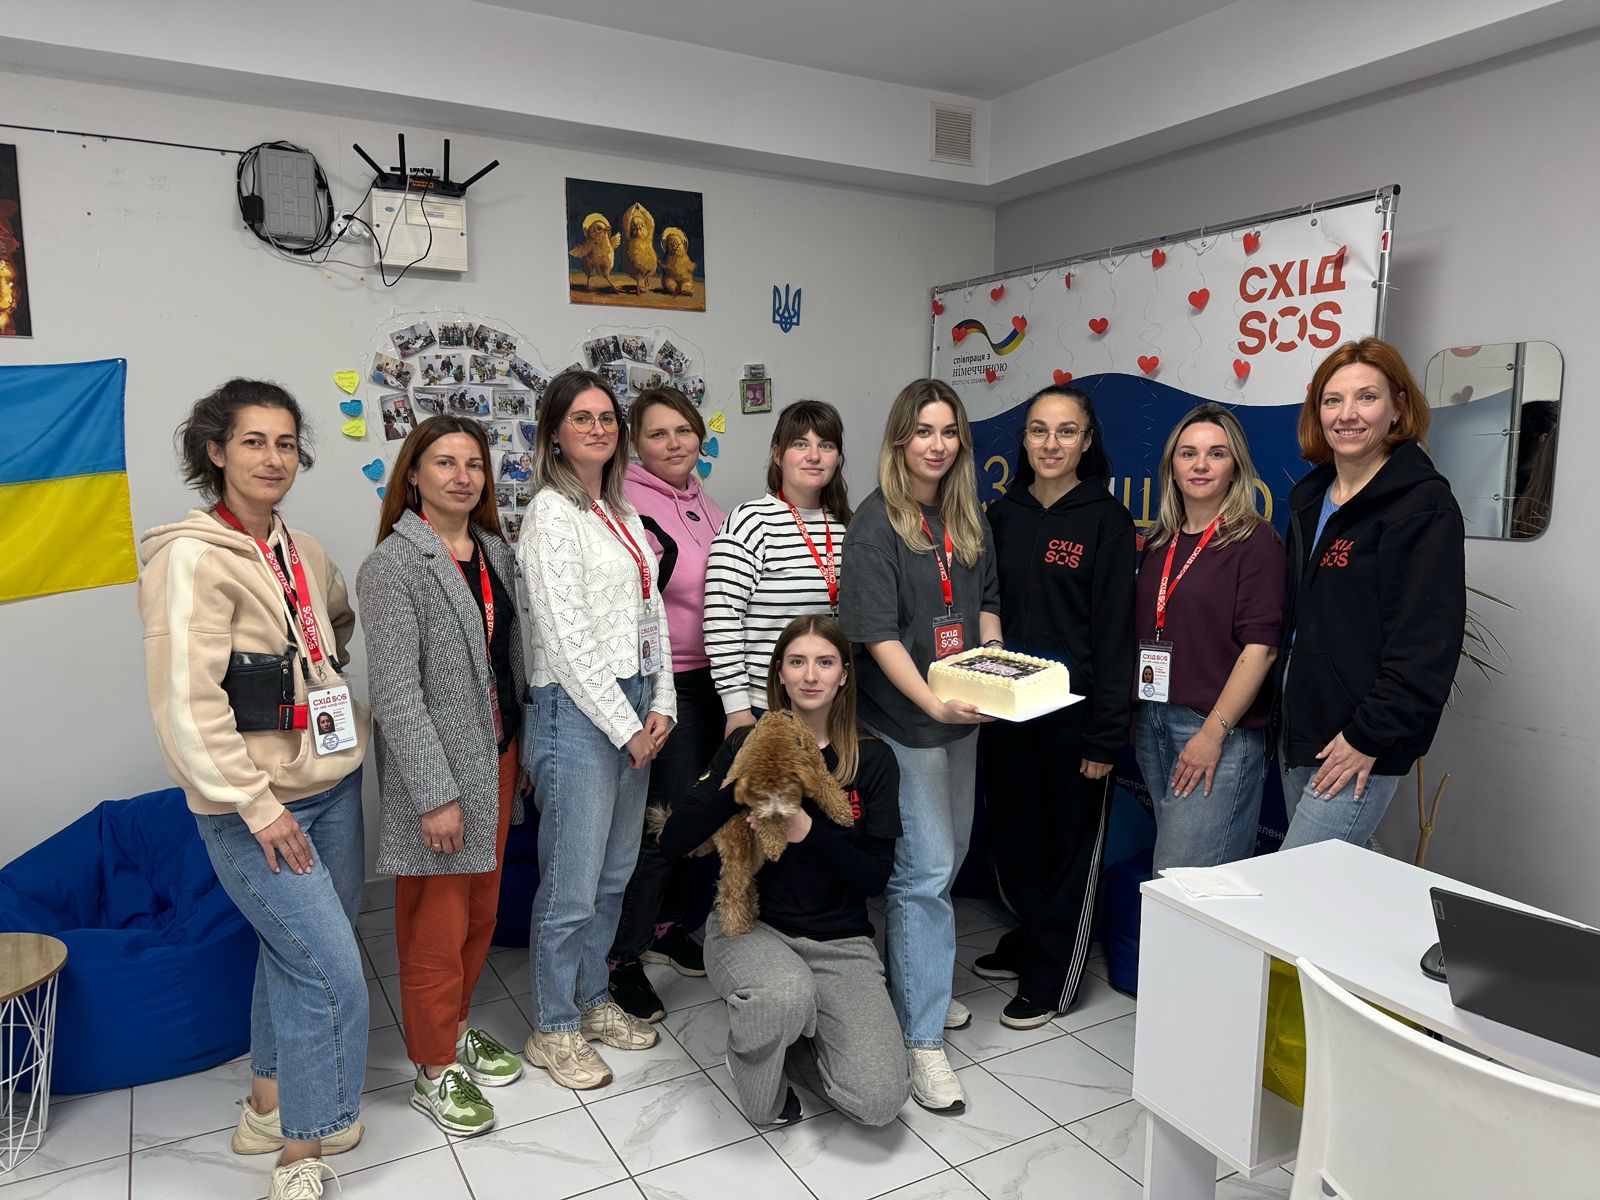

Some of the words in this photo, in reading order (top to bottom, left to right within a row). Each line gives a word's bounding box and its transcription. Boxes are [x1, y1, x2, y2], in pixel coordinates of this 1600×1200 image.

[1239, 255, 1346, 303] СХІД
[1237, 301, 1343, 355] SOS
[953, 354, 985, 365] співпраця
[1048, 539, 1084, 556] СХІД
[265, 552, 281, 572] SOS
[1044, 550, 1081, 569] SOS
[276, 570, 292, 594] СХІД
[1159, 577, 1169, 595] СХІД
[1157, 595, 1167, 612] SOS
[303, 605, 315, 626] SOS
[941, 629, 958, 639] СХІД
[941, 638, 959, 648] SOS
[313, 697, 332, 706] СХІД
[332, 693, 348, 702] SOS
